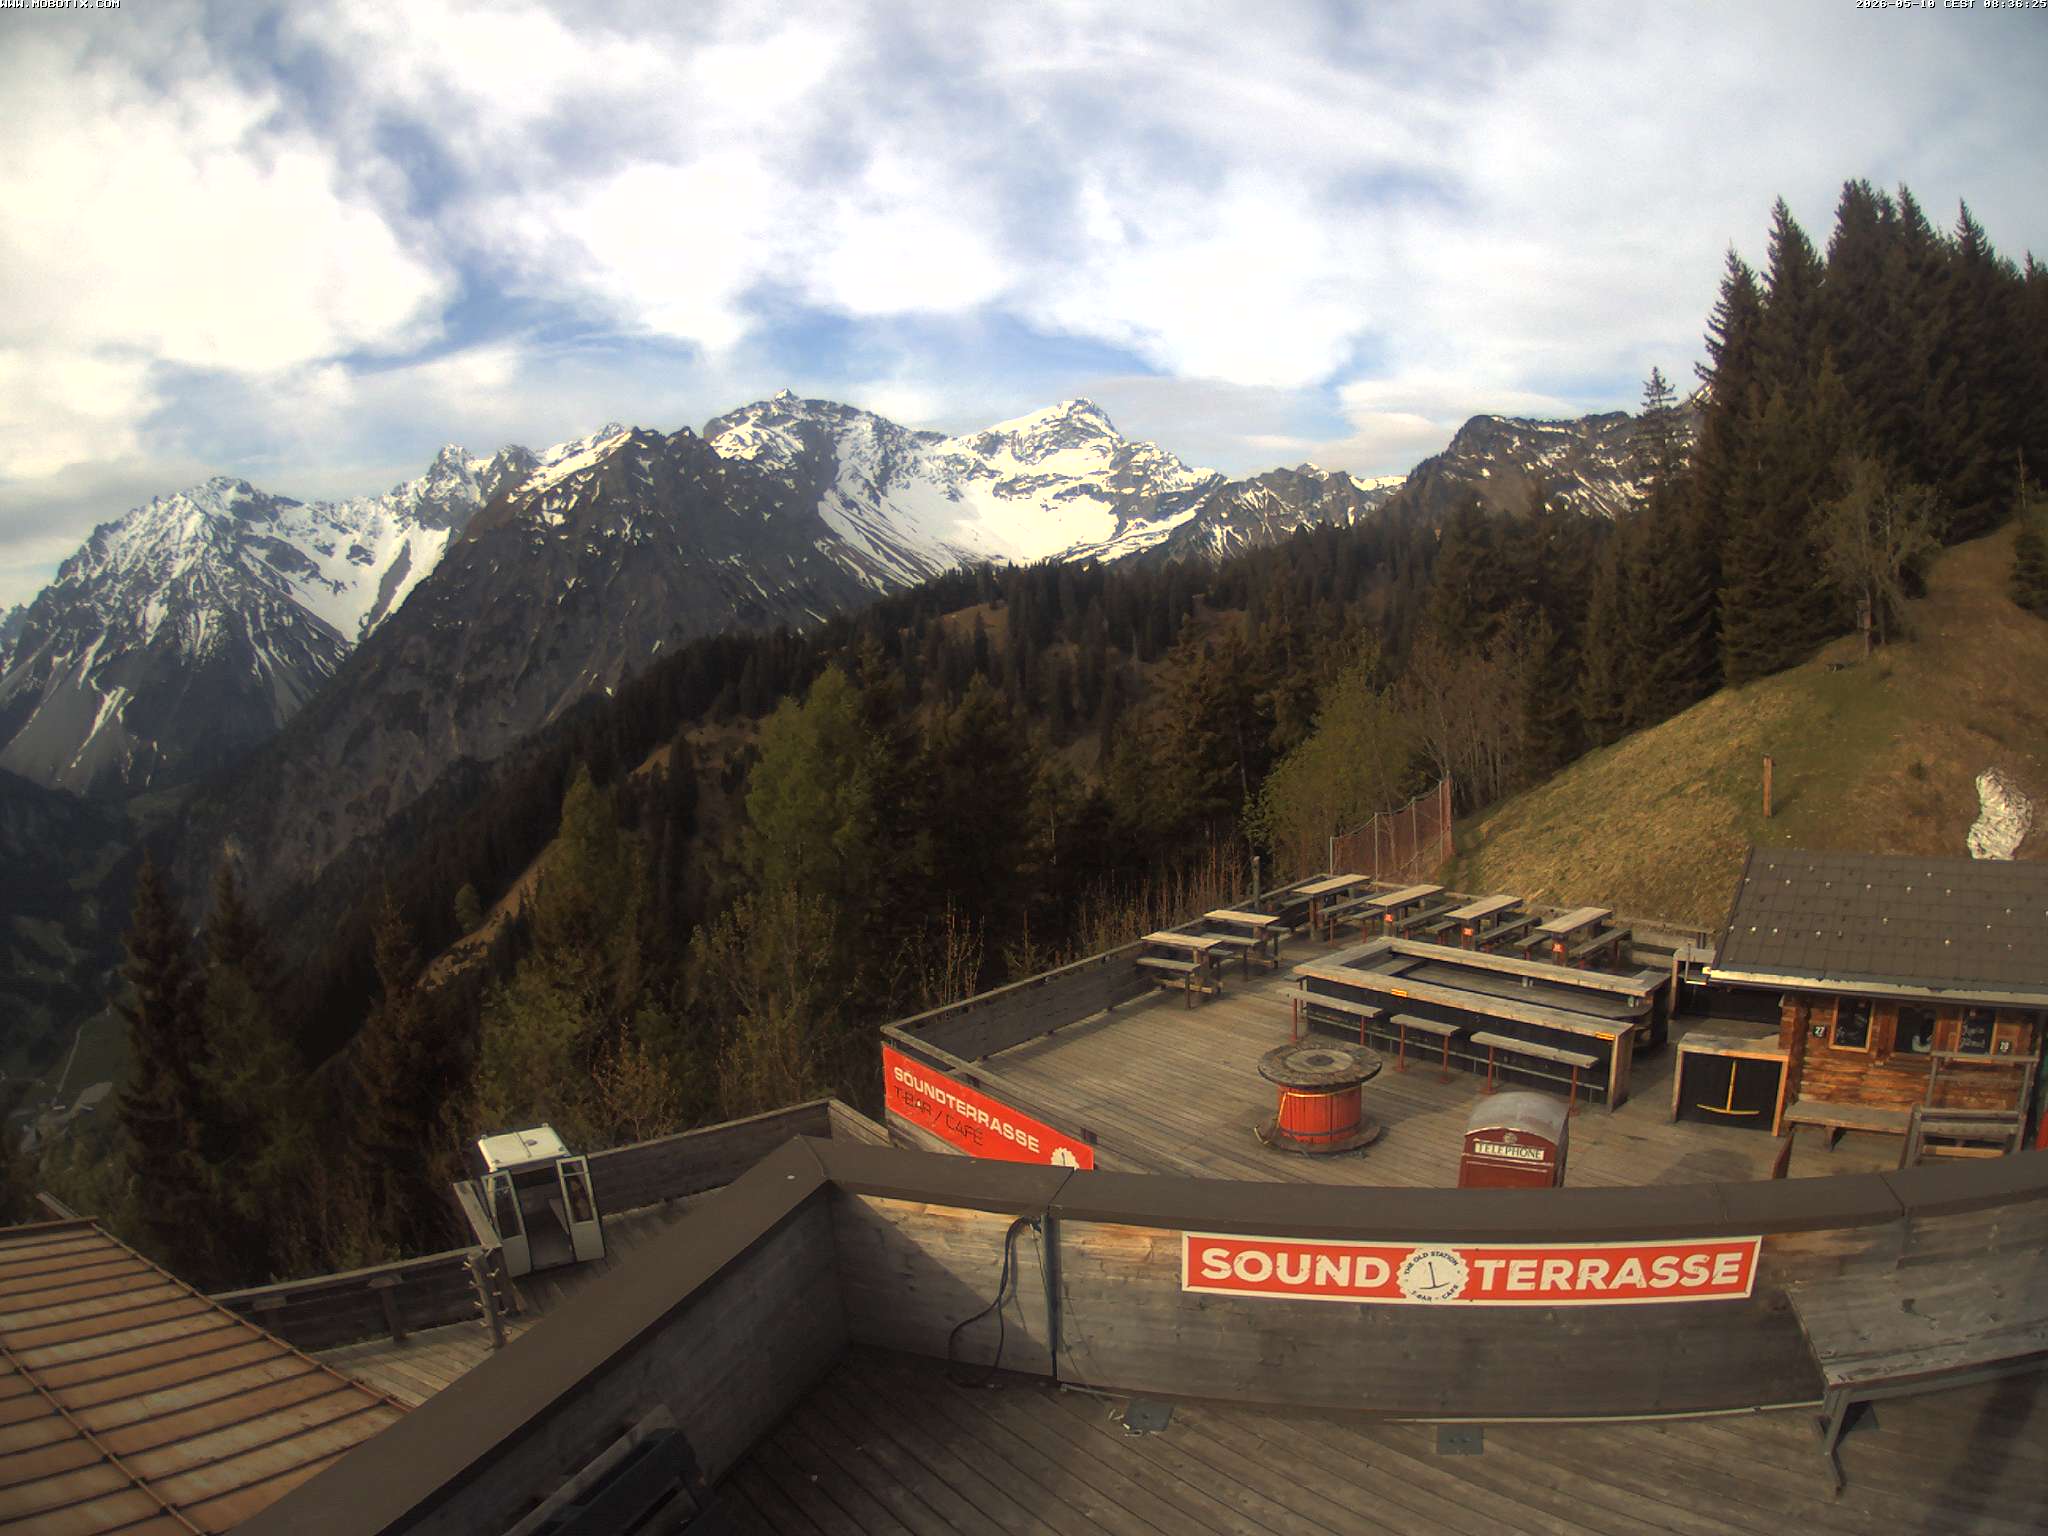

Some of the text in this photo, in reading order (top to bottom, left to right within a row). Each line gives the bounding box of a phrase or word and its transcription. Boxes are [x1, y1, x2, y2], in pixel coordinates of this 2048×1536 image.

[893, 1066, 1041, 1154] SOUNDTERRASSE
[1475, 1143, 1542, 1159] TELEPHONE
[1200, 1248, 1743, 1291] SOUND TERRASSE
[1404, 1251, 1459, 1276] THE OLD STATION
